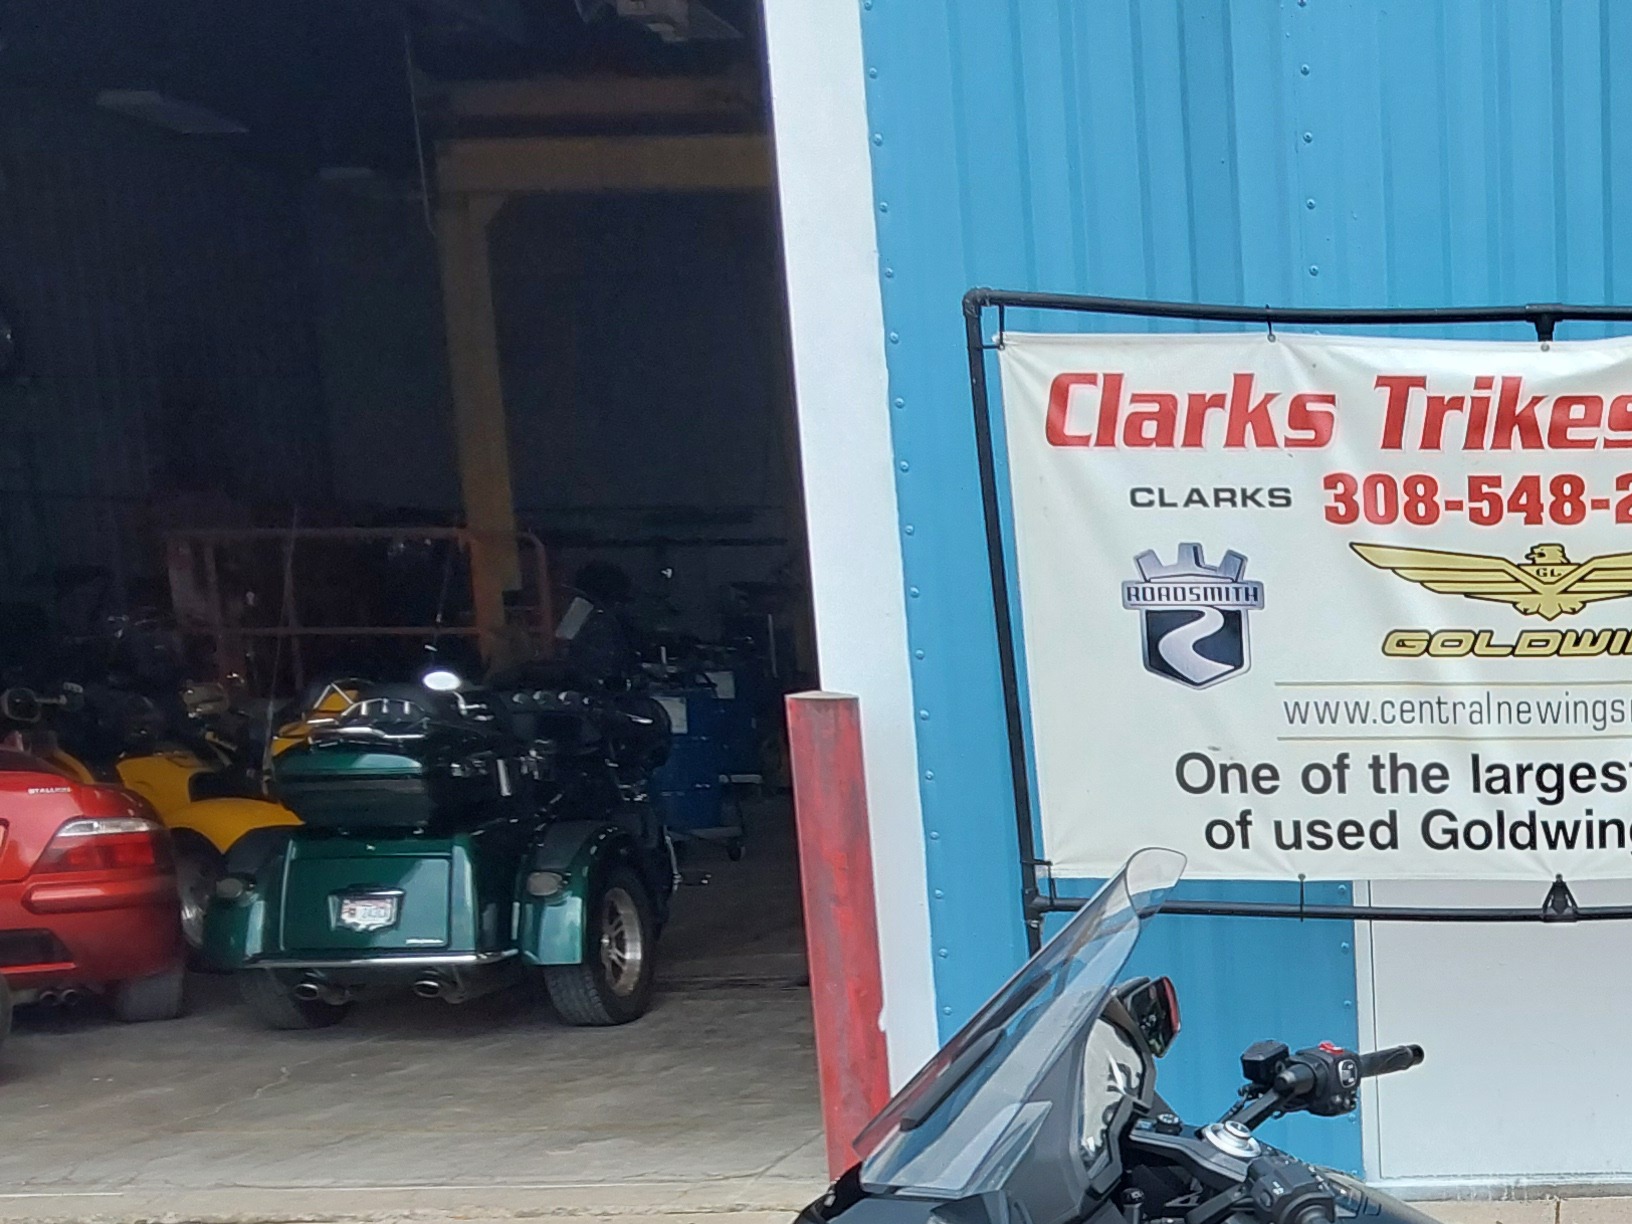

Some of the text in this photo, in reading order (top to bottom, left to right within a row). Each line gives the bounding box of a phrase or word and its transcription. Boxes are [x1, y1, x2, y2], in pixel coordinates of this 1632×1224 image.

[1044, 371, 1337, 450] Clarks
[1129, 486, 1293, 509] CLARKS
[1535, 567, 1562, 578] GL
[1125, 584, 1261, 604] ROADSMITH
[1174, 751, 1281, 795] One
[1300, 751, 1351, 795] of
[1367, 751, 1450, 795] the
[1204, 808, 1253, 851] of
[1273, 808, 1400, 851] used
